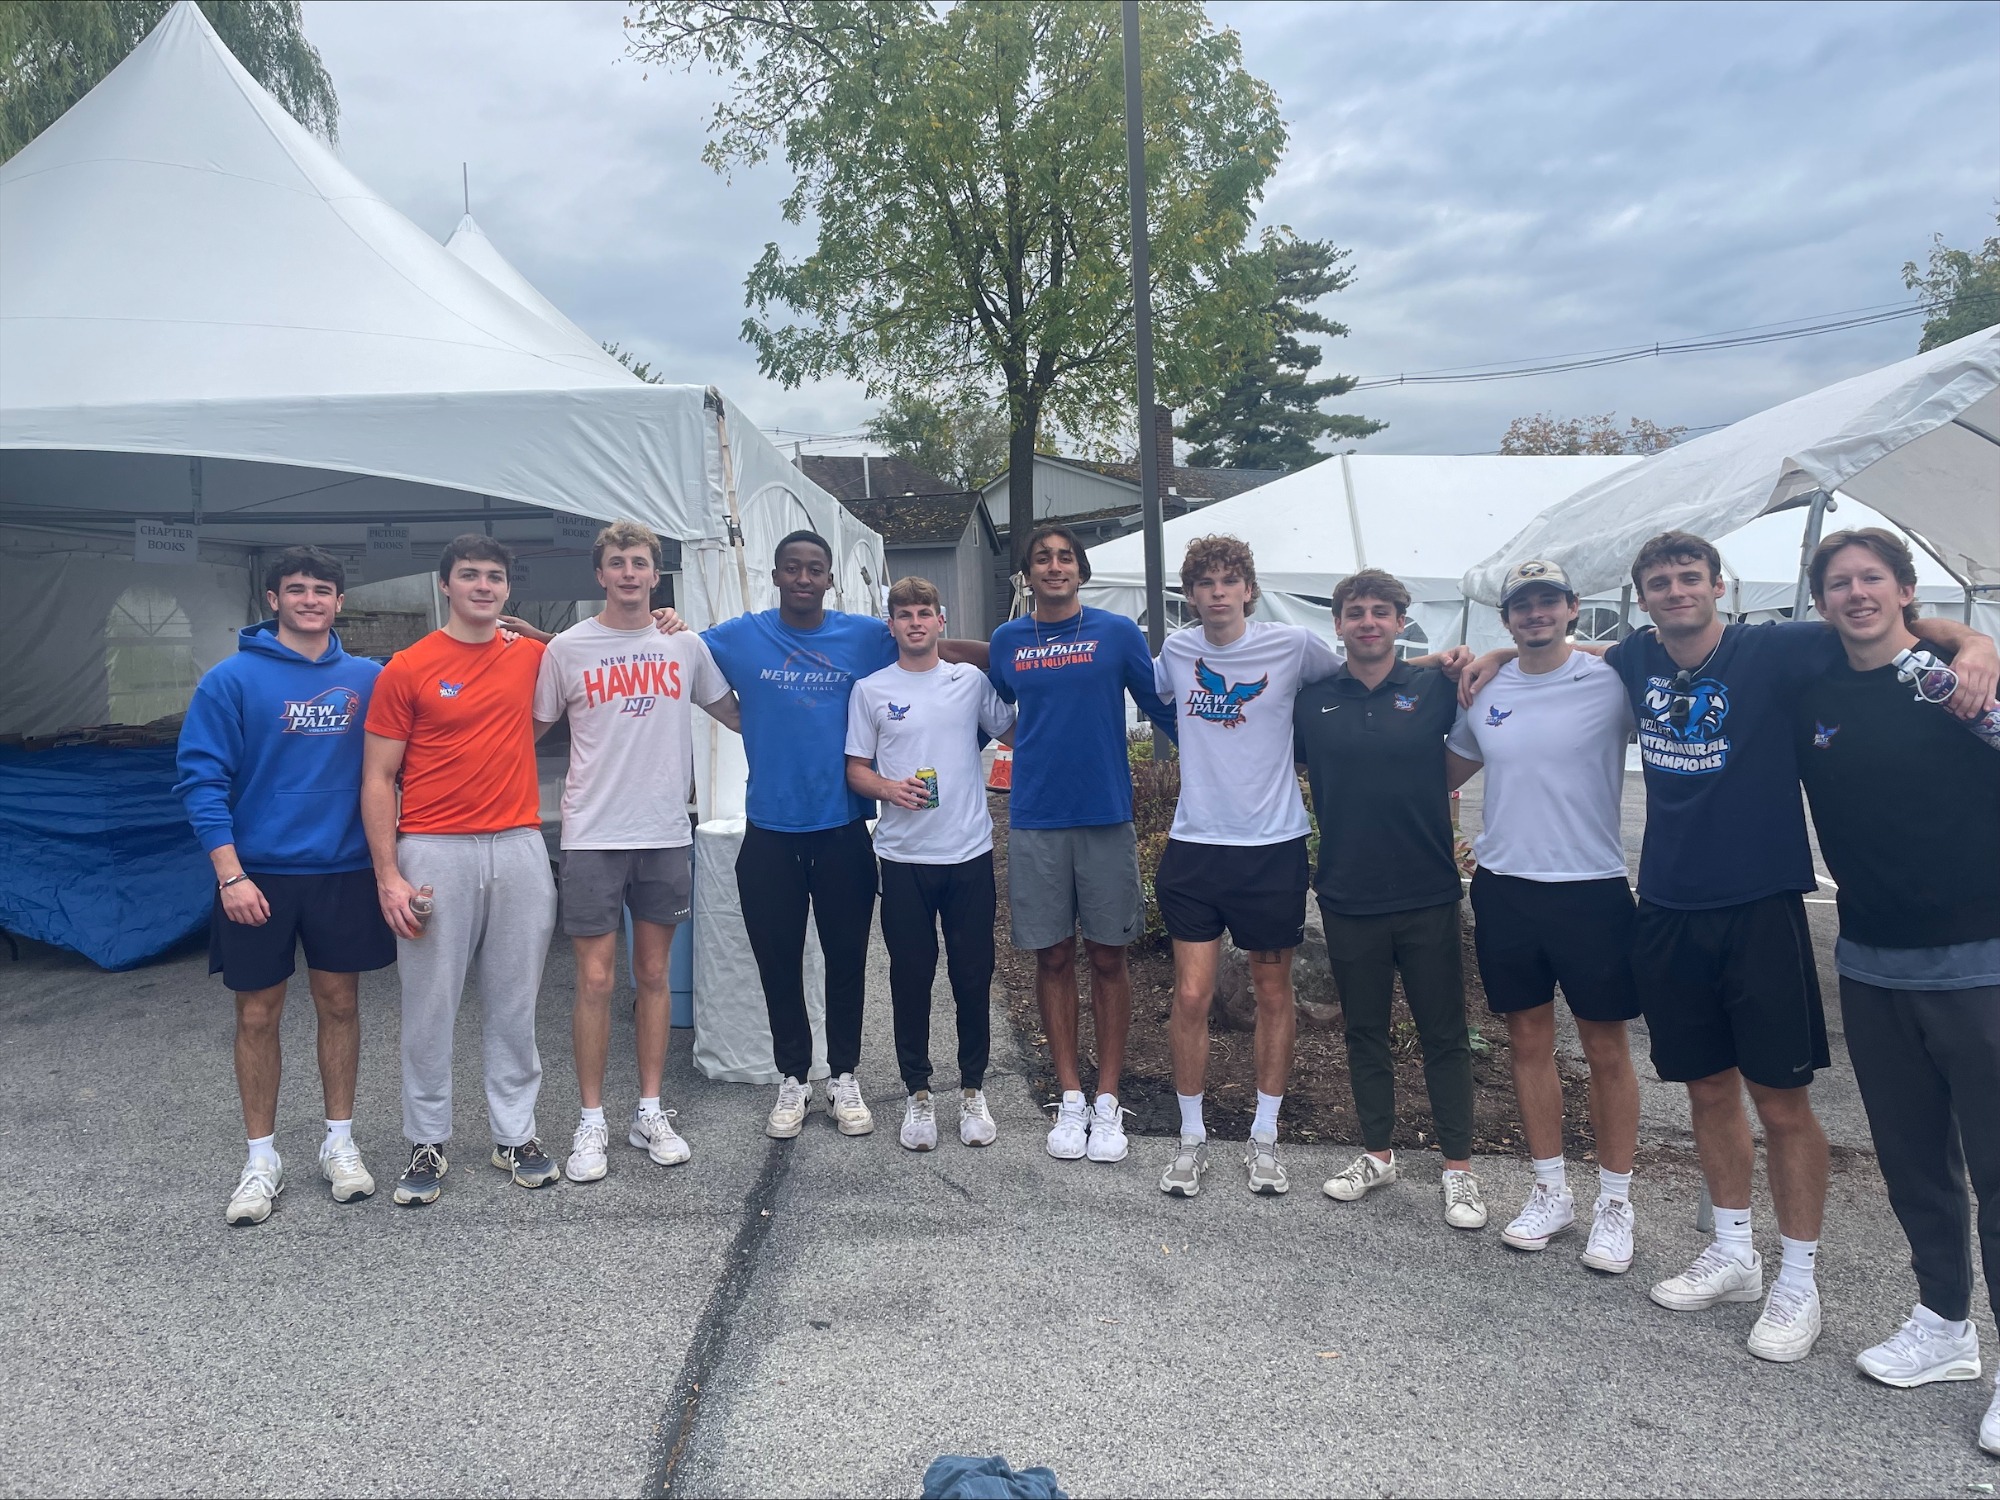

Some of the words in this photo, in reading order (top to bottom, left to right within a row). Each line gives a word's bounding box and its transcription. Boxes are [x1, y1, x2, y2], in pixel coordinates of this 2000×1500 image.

[556, 515, 596, 527] CHAPTER
[140, 525, 193, 538] CHAPTER
[369, 529, 407, 538] PICTURE
[562, 528, 590, 537] BOOKS
[147, 540, 185, 552] BOOKS
[373, 541, 403, 550] BOOKS
[1016, 647, 1050, 661] NEW
[1048, 642, 1095, 656] PALTZ
[600, 655, 626, 667] NEW
[632, 653, 665, 662] PALTZ
[1015, 660, 1040, 672] MEN'S
[1041, 653, 1093, 668] VOLLEYBALL
[760, 668, 801, 682] NEW
[803, 671, 852, 683] PALTZ
[583, 661, 681, 709] HAWKS
[1190, 691, 1228, 704] NEW
[288, 703, 335, 717] NEW
[620, 697, 656, 717] NP
[1191, 704, 1241, 715] PALTZ
[289, 714, 350, 731] PALTZ
[1641, 733, 1729, 756] INTRAMURAL
[1643, 749, 1722, 772] CHAMPIONS
